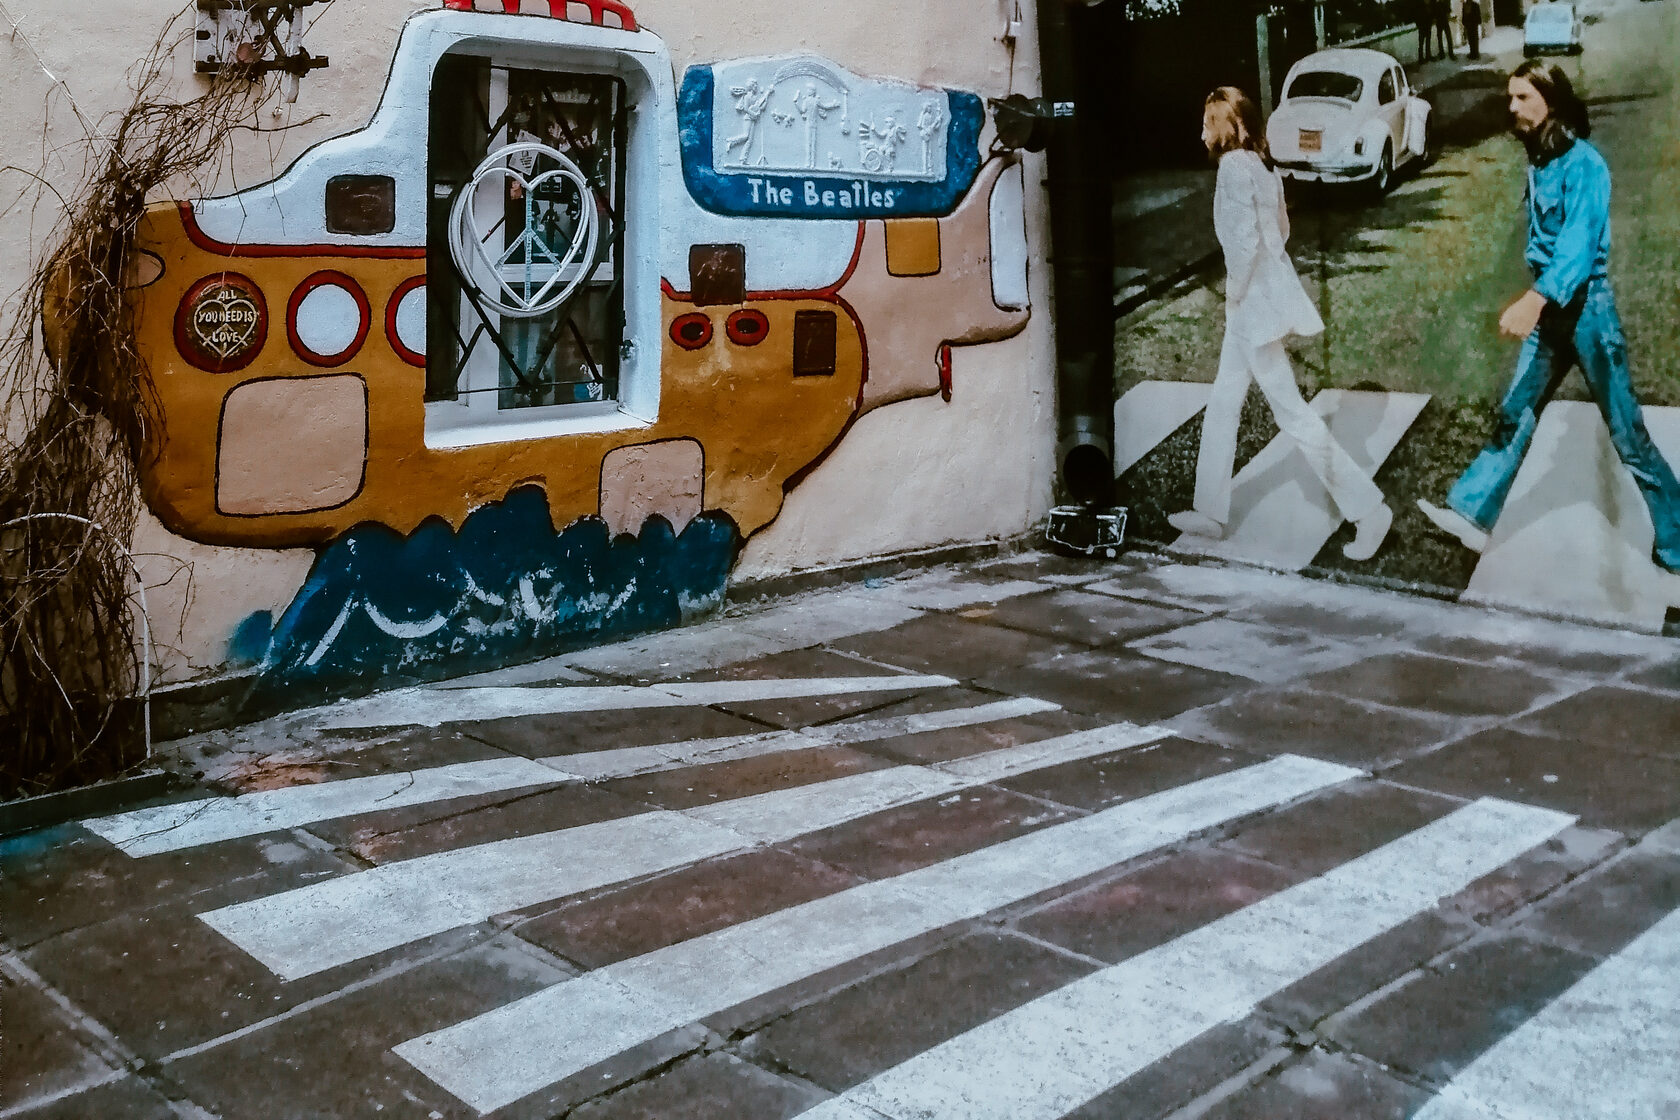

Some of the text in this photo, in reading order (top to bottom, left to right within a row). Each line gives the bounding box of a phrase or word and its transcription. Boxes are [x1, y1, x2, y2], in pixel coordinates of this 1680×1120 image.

[748, 178, 896, 208] The Beatles
[216, 290, 237, 301] ALL
[198, 310, 254, 323] YOU NEED IS
[212, 331, 239, 343] LOVE
